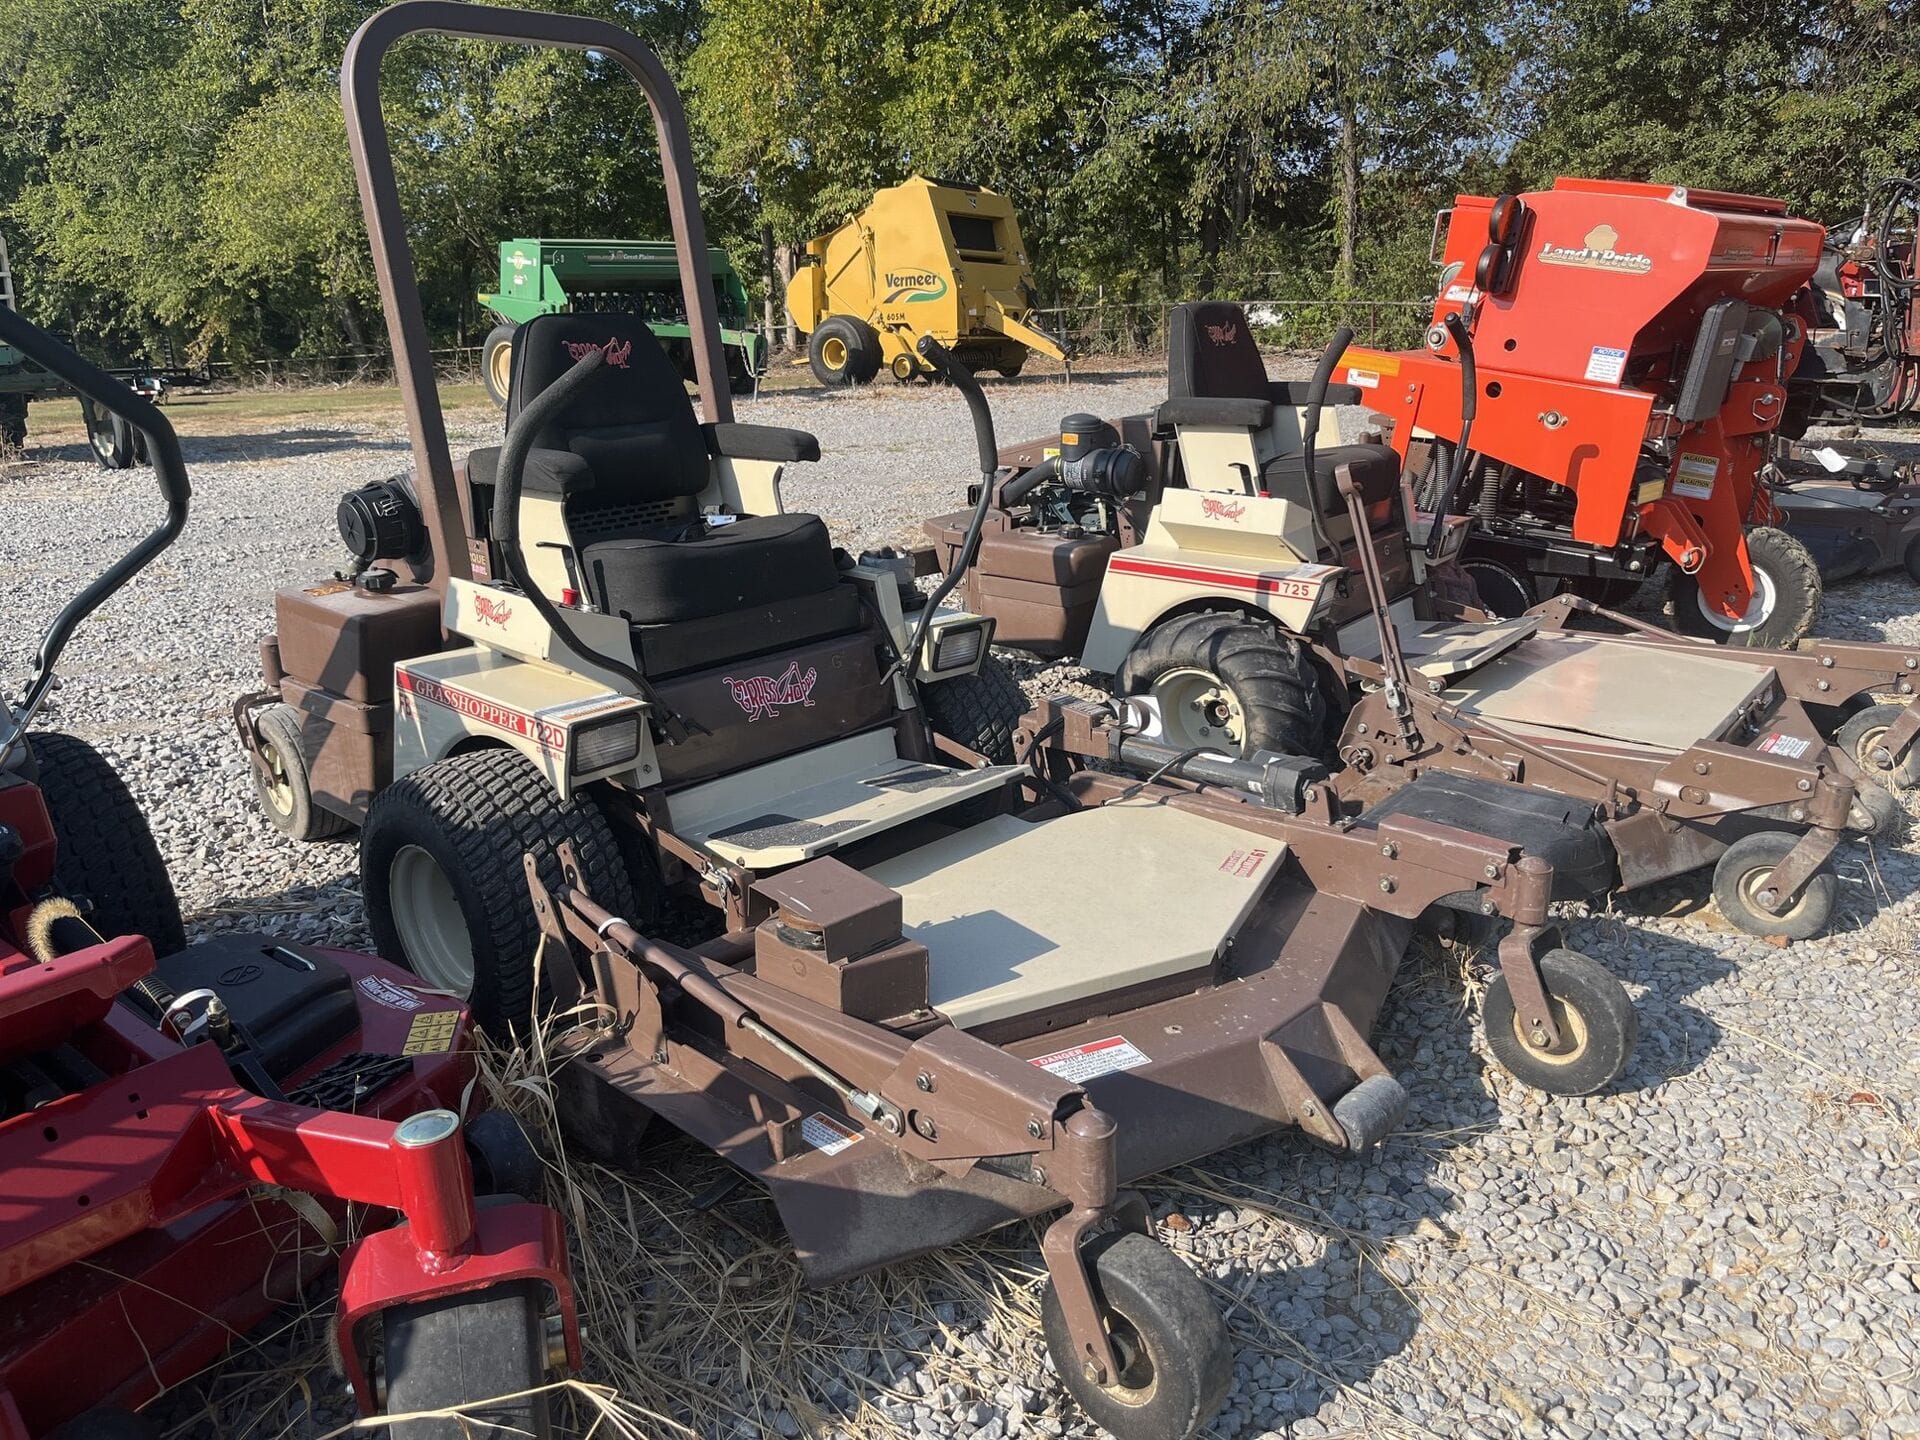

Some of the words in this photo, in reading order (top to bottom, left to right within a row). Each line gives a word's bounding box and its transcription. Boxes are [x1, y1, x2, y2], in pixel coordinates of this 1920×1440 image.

[1540, 242, 1590, 260] Land
[1599, 249, 1652, 268] Pride
[885, 273, 937, 288] Vermeer
[887, 312, 905, 321] 605M
[1689, 455, 1717, 464] CAUTION
[1685, 478, 1710, 487] CAUTION
[1282, 582, 1310, 597] 725
[415, 679, 520, 732] GRASSHOPPER
[527, 719, 564, 749] 722D
[1039, 1049, 1083, 1065] DANGER
